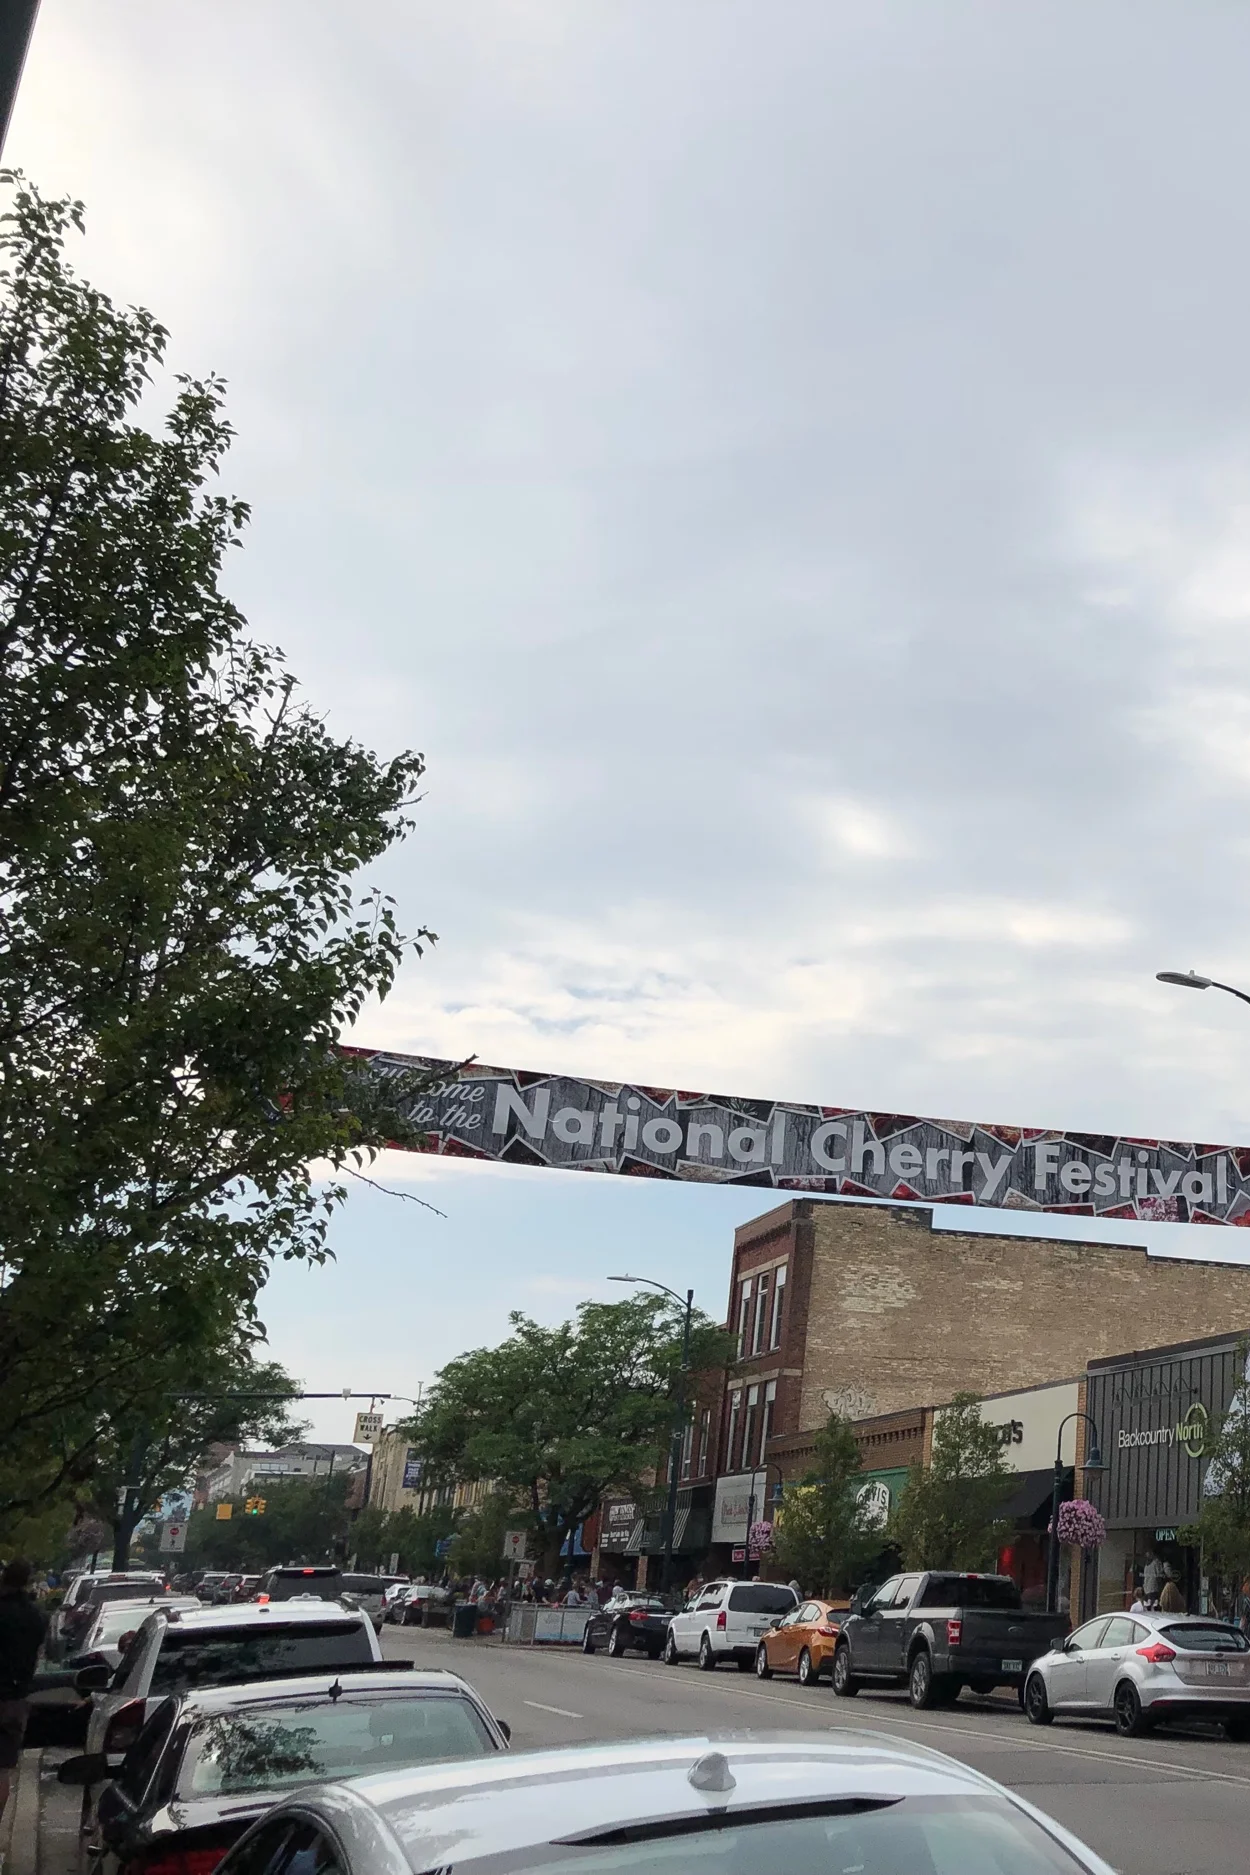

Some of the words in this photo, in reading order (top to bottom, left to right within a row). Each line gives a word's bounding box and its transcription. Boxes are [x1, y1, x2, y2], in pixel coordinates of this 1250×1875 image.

[406, 1101, 434, 1124] to
[439, 1104, 482, 1130] the
[492, 1083, 787, 1166] National
[810, 1119, 1013, 1200] Cherry
[1034, 1144, 1230, 1205] Festival
[359, 1415, 382, 1424] CROSS
[360, 1424, 378, 1432] WALK
[1118, 1426, 1175, 1448] Backcountry
[1175, 1421, 1203, 1442] North
[1155, 1528, 1176, 1542] OPEN
